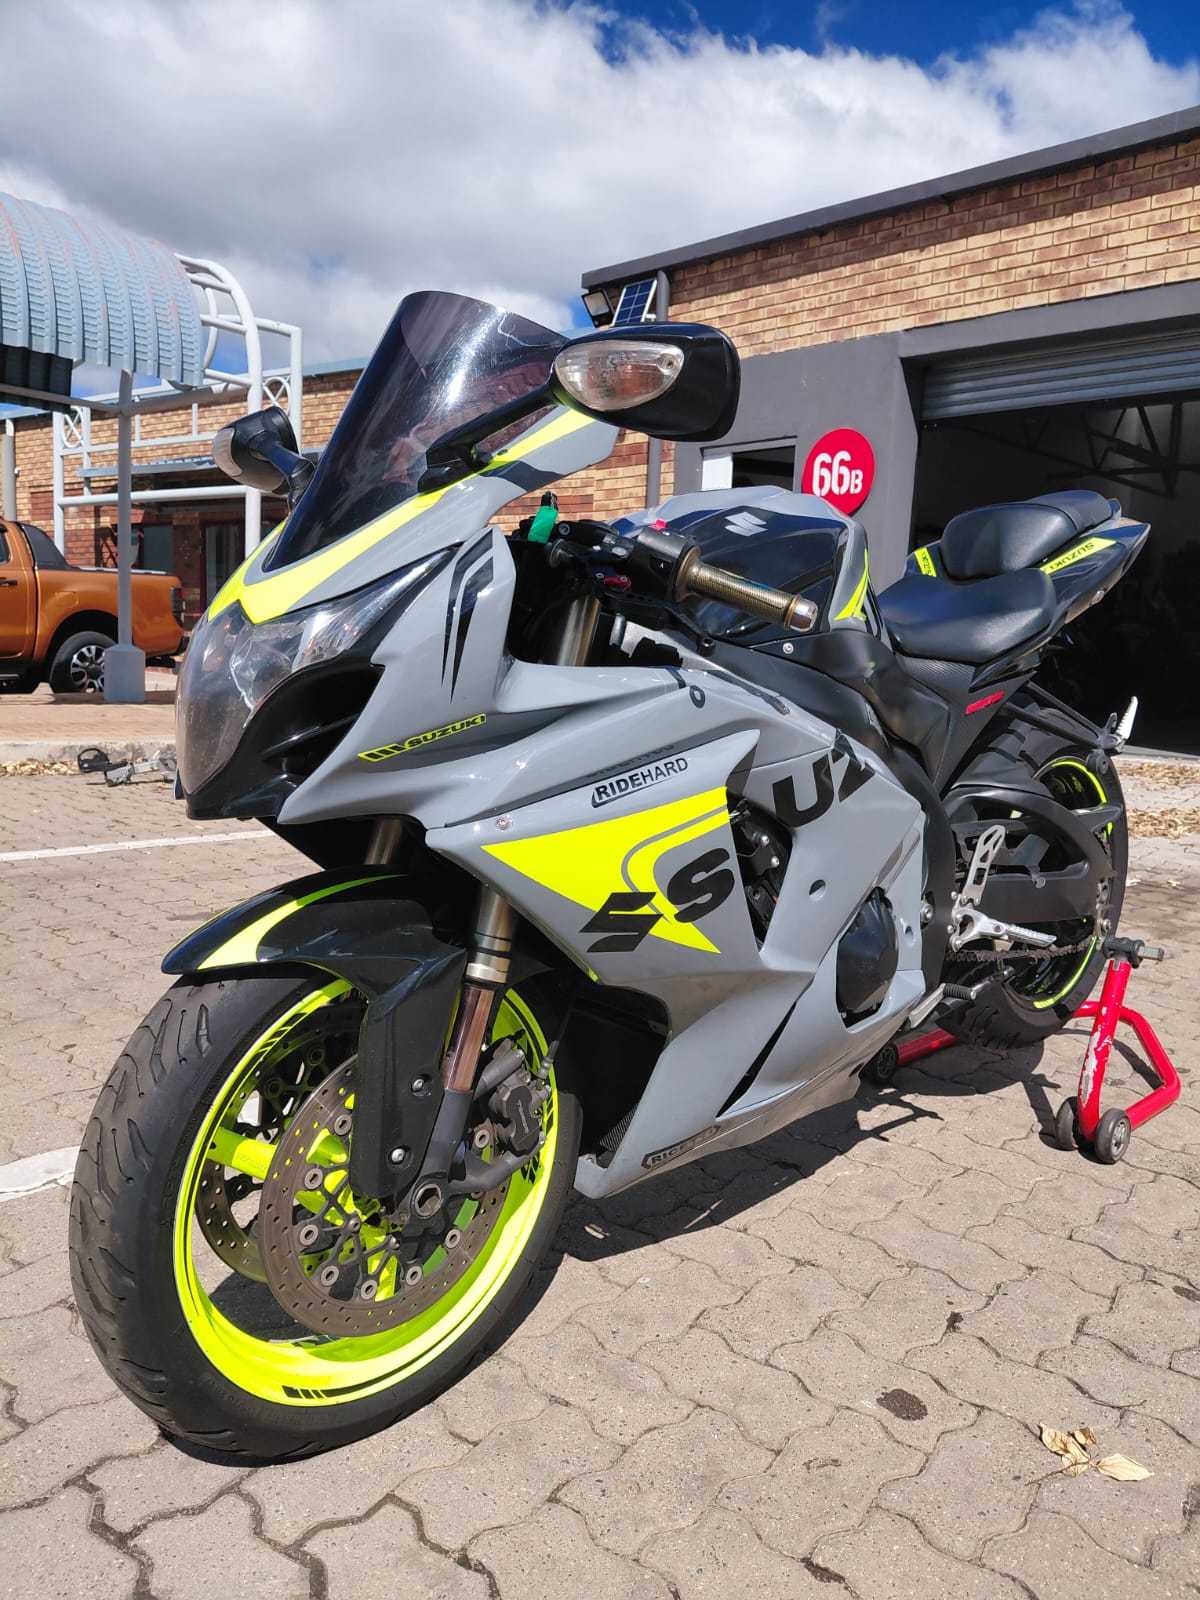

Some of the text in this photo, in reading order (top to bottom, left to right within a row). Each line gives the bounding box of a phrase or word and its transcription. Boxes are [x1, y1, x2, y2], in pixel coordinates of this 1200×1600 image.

[812, 450, 864, 496] 66B
[1048, 541, 1095, 570] SUZUKI
[407, 715, 486, 748] SUZUKI
[595, 757, 688, 801] RIDEHARD
